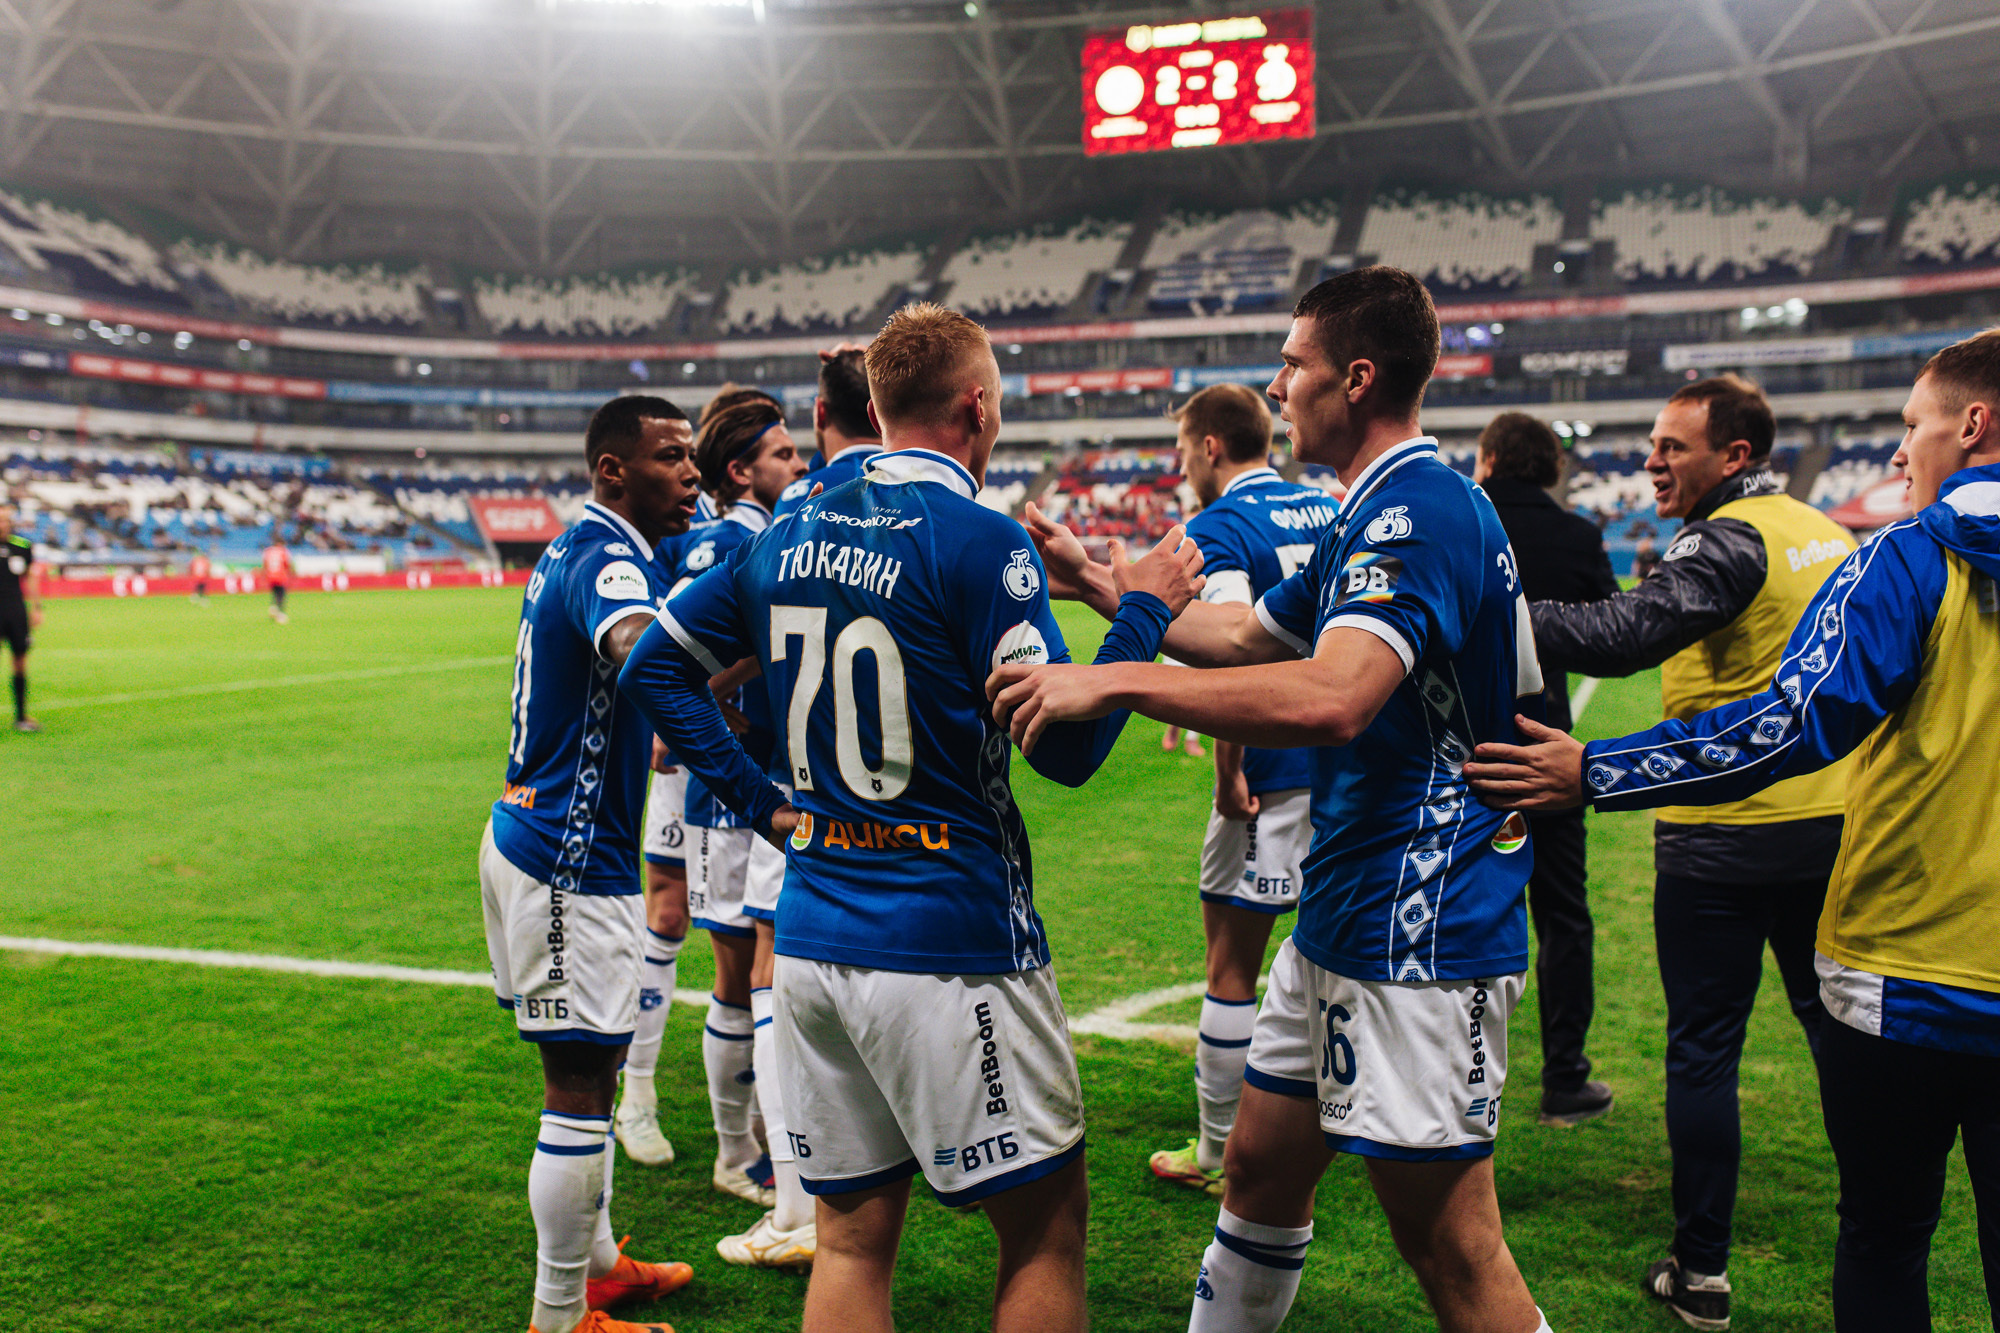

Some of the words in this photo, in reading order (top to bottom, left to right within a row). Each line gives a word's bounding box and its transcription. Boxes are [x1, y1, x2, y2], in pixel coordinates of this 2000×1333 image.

[777, 540, 902, 600] ТЮКАВИН
[770, 604, 914, 801] 70
[1257, 877, 1291, 895] ВТБ
[548, 886, 564, 981] BetBoom
[527, 998, 569, 1019] ВТБ
[974, 1001, 1008, 1117] BetBoom
[1320, 1099, 1347, 1120] OSCO
[787, 1131, 812, 1158] ТБ
[961, 1131, 1020, 1173] ВТБ
